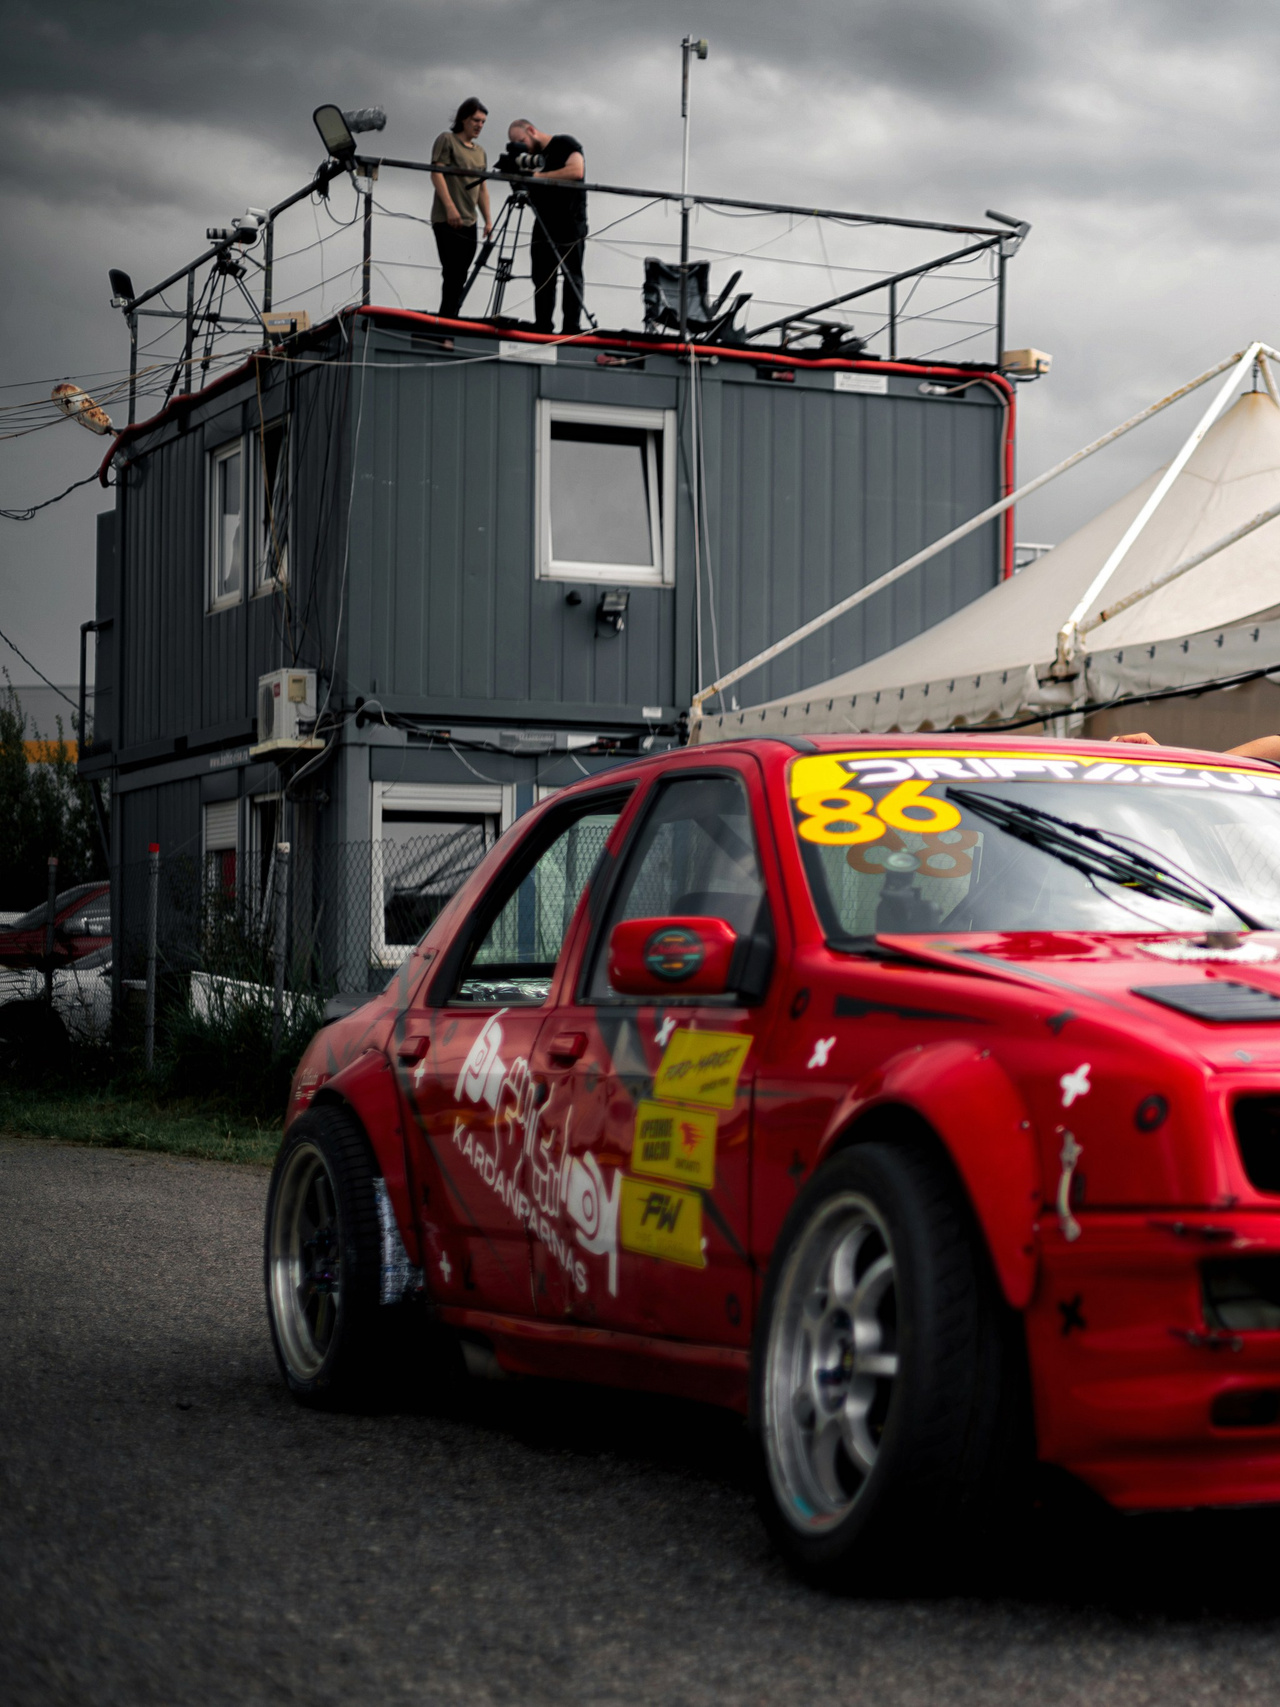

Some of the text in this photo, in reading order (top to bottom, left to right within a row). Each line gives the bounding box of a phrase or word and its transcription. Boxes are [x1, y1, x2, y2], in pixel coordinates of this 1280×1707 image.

[848, 757, 1078, 785] DRIFT
[796, 779, 962, 846] 86
[453, 1116, 587, 1293] KARDANPARNAS
